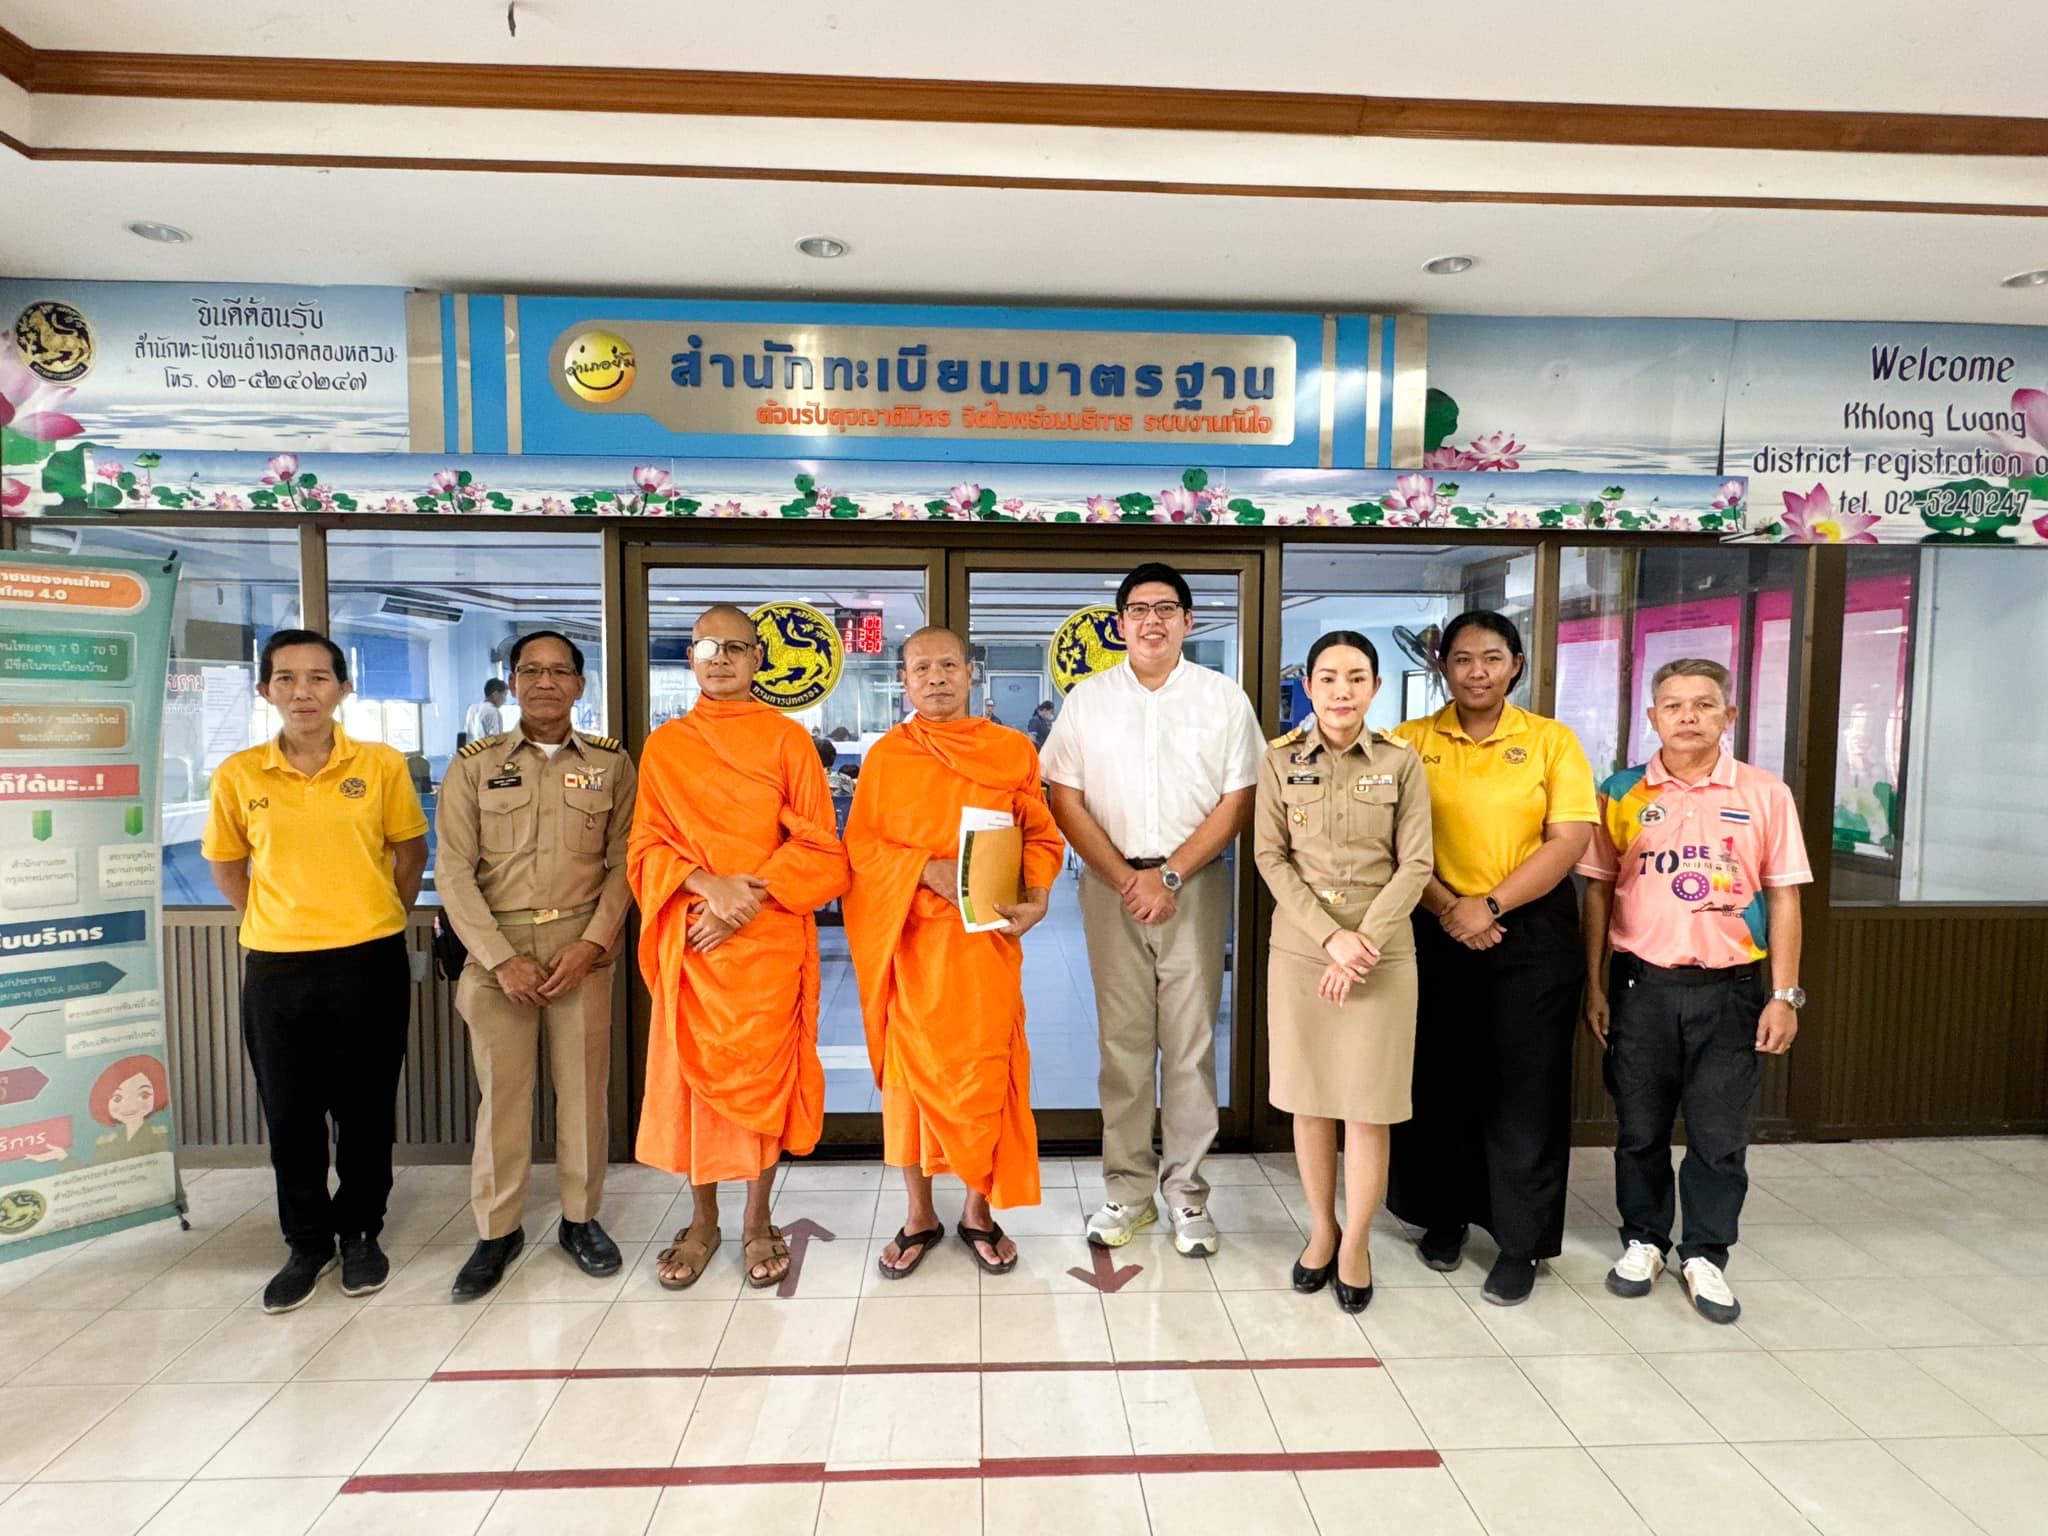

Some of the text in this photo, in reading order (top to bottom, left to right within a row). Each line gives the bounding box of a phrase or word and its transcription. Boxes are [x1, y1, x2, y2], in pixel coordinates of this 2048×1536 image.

[192, 296, 324, 329] ยินดีต้อนรับ
[134, 332, 395, 363] สำนักทะเบียนอำเภอคลองหลวง
[1871, 345, 2015, 382] Welcome
[164, 366, 368, 391] โทร. ๐๒-๕๒๔๐๒๔๗
[670, 334, 1275, 410] สำนักทะเบียนมาตรฐาน
[961, 400, 1133, 431] จิตใจพร้อมบริการ
[1144, 405, 1273, 433] ระบบงานทันใจ
[1843, 402, 2027, 439] Khlong Luang
[1752, 445, 1851, 474] district
[1864, 446, 2022, 481] registration
[1839, 490, 2029, 516] tel. 02-5240247
[1682, 845, 1711, 860] BE
